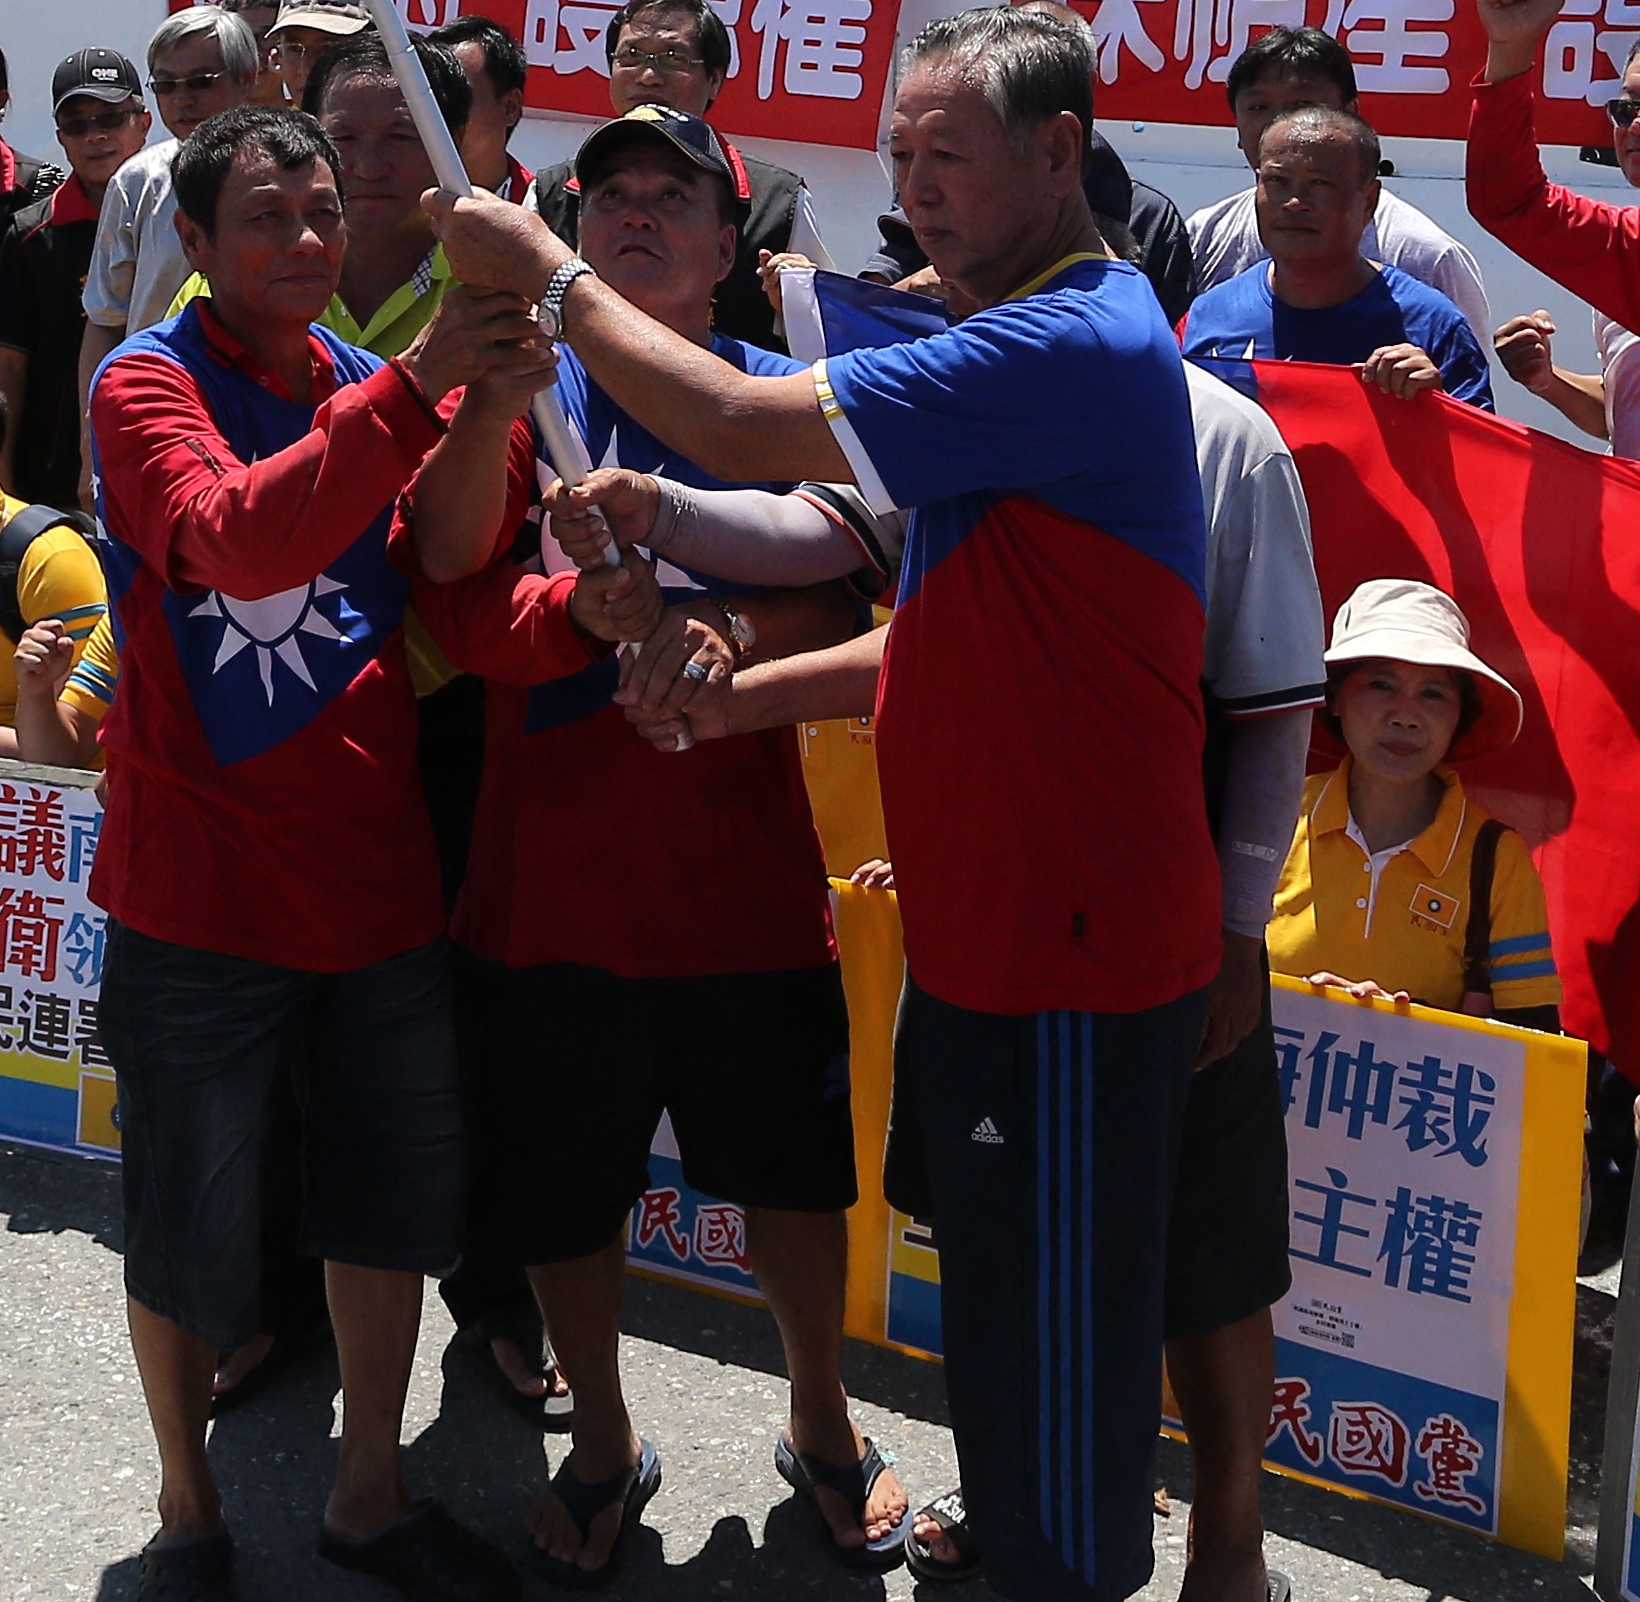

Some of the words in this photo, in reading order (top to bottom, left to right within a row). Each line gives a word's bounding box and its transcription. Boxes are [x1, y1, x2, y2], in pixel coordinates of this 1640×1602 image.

[971, 1132, 1005, 1144] adidas
[637, 1186, 753, 1275] 民國
[1288, 1165, 1483, 1304] 主權
[1264, 1376, 1488, 1517] 民國黨
